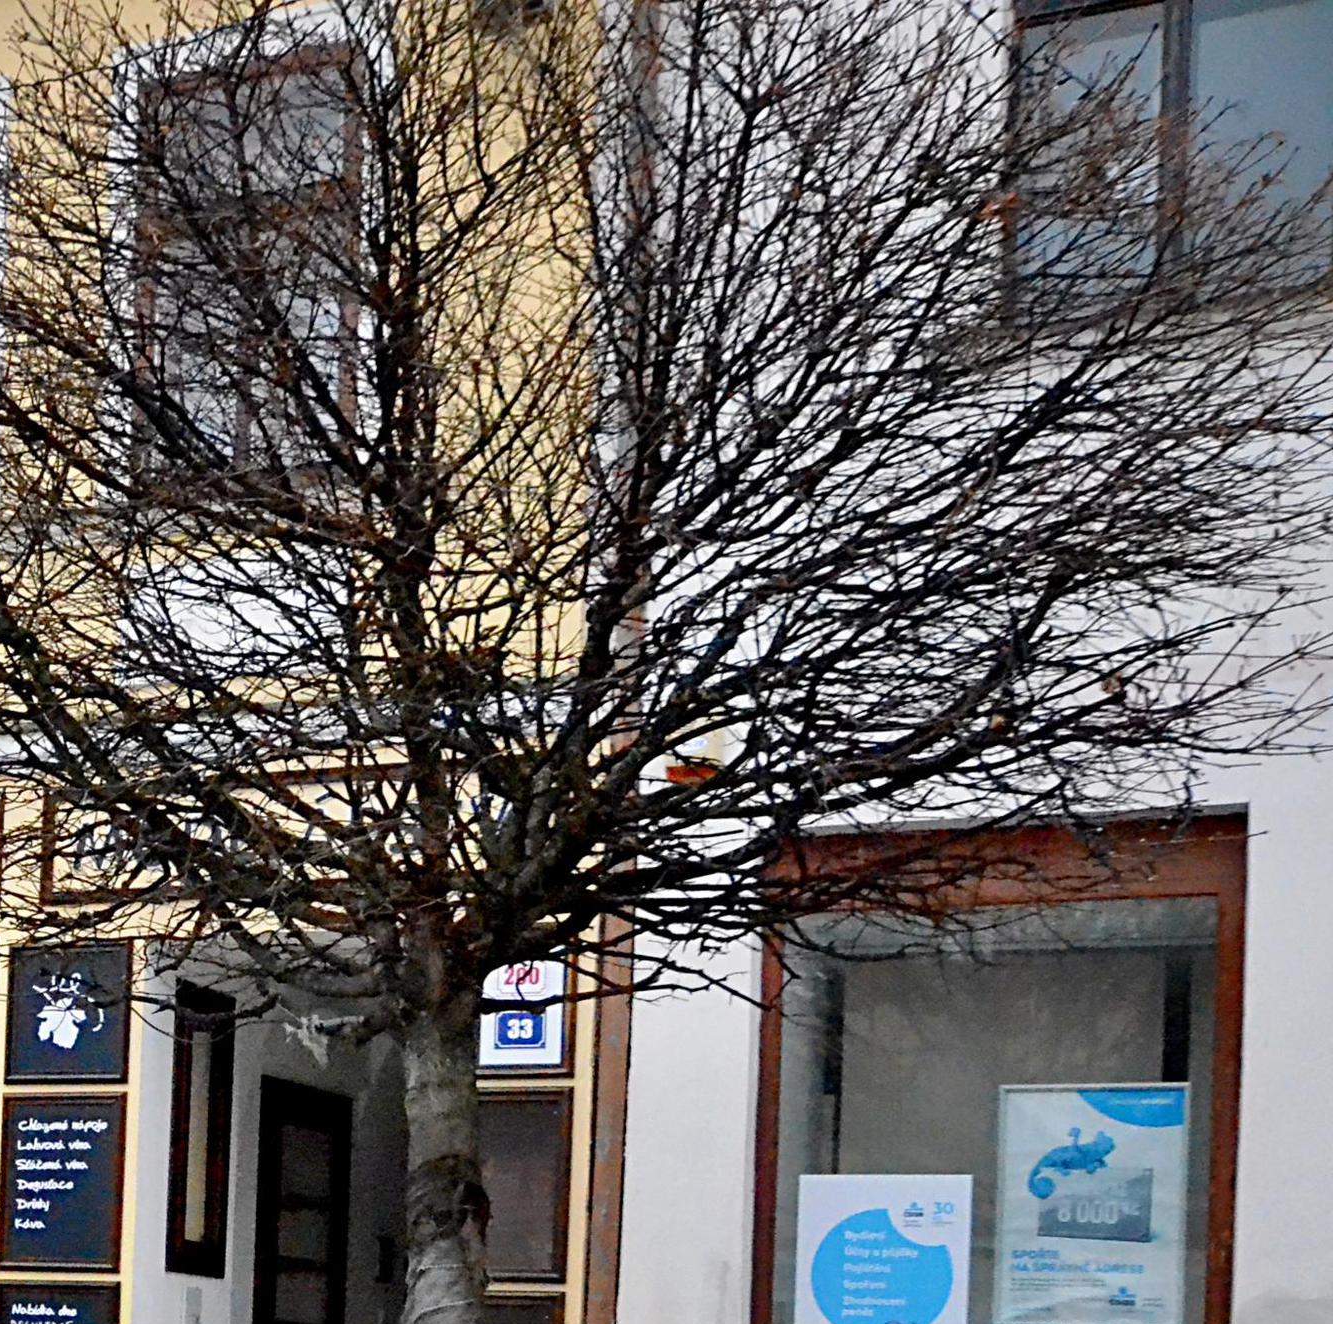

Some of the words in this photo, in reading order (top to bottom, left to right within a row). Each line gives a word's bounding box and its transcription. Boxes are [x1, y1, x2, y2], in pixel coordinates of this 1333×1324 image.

[506, 1018, 534, 1040] 33
[68, 1139, 92, 1150] vína
[65, 1159, 89, 1170] vína
[16, 1178, 75, 1193] Degustace
[14, 1218, 46, 1230] Káva
[11, 1303, 55, 1316] Nabídka
